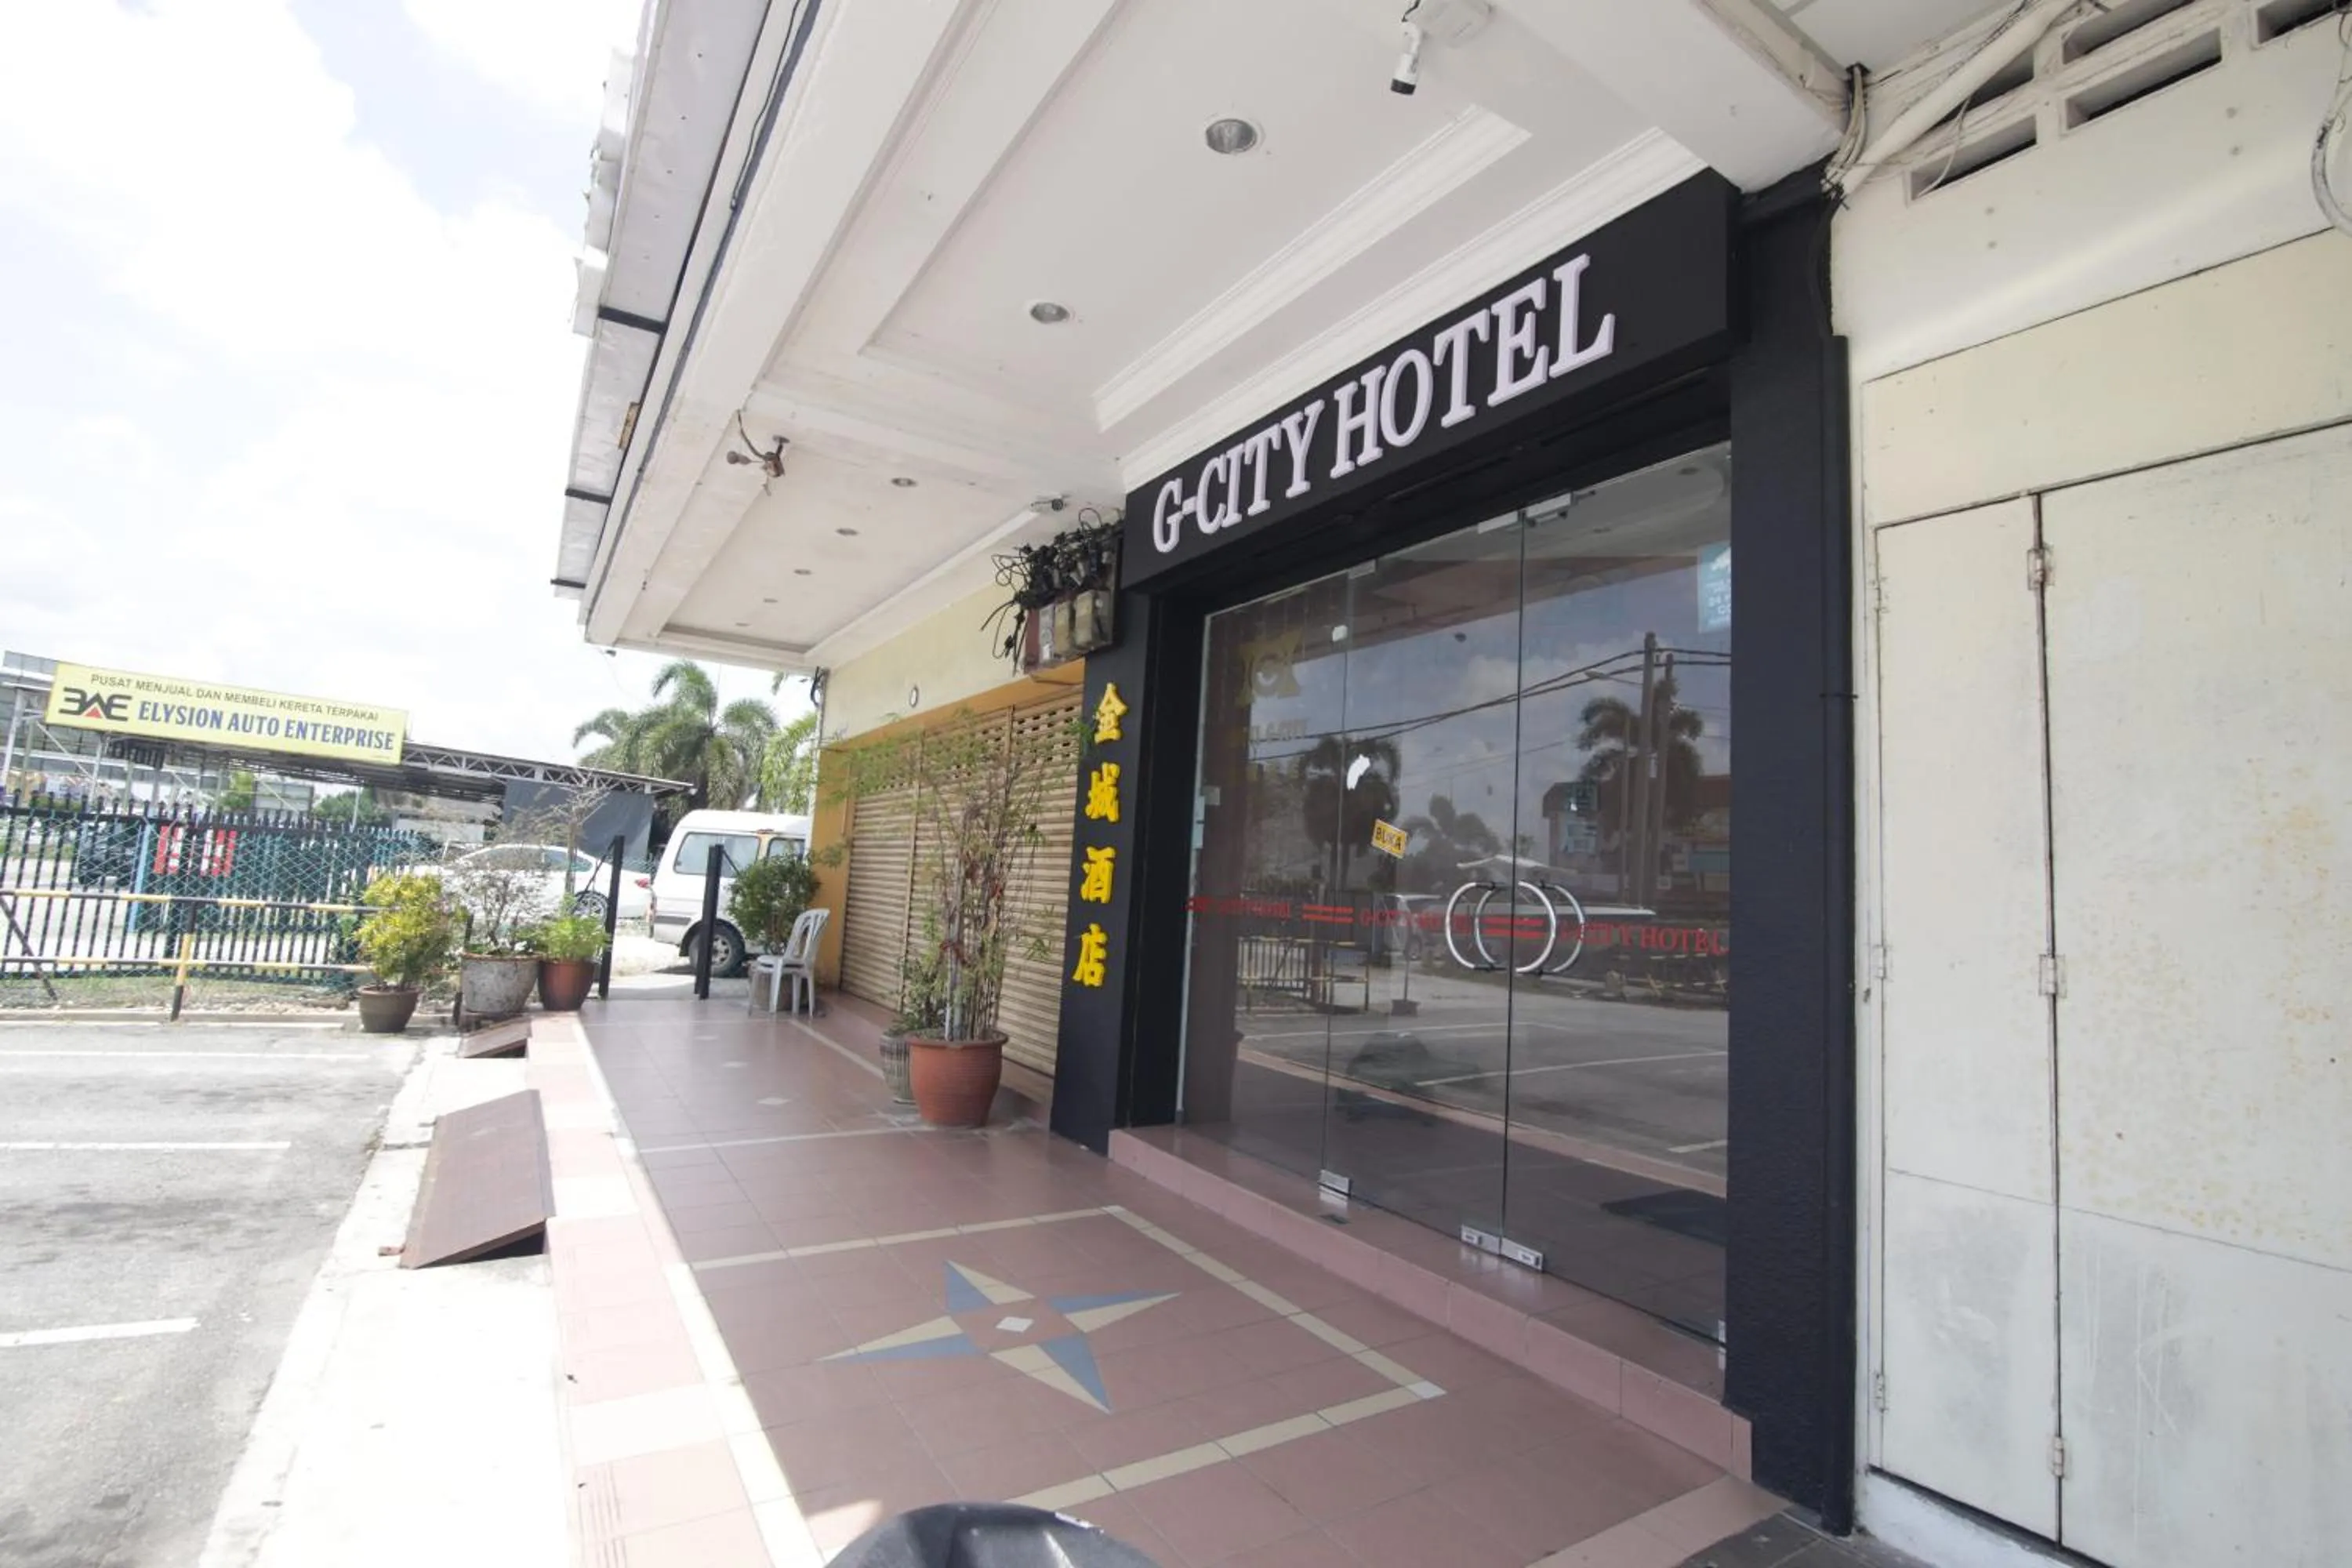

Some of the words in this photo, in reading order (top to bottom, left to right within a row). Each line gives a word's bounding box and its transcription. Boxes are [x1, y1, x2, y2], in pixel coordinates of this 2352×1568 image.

[1152, 398, 1325, 554] G-CITY
[1330, 253, 1615, 478] HOTEL
[91, 673, 132, 688] PUSAT
[135, 679, 193, 697] MENJUAL
[197, 688, 222, 700] DAN
[224, 691, 277, 709] MEMBELI
[278, 700, 322, 715] KERETA
[326, 706, 379, 721] TERPAKAI
[138, 700, 223, 730] ELYSION
[227, 712, 280, 736] AUTO
[284, 718, 395, 750] ENTERPRISE
